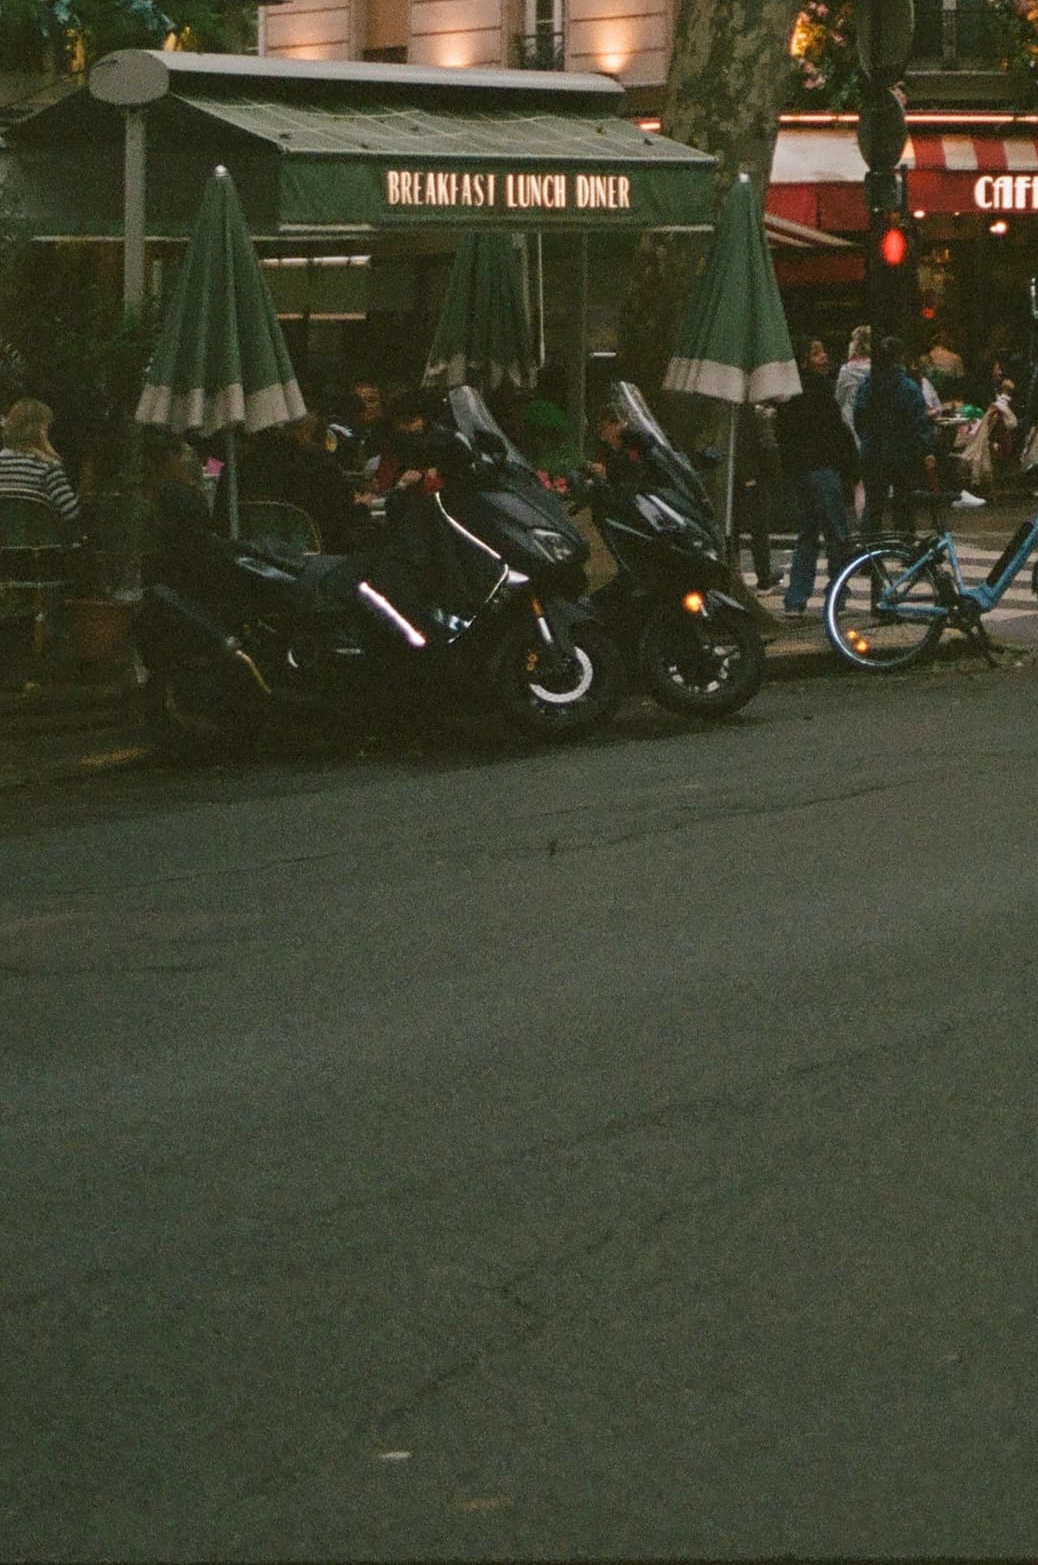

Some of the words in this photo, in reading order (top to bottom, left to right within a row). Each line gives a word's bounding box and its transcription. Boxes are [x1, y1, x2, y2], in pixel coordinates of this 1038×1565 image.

[386, 170, 496, 207] BREAKFAST
[506, 173, 567, 209] LUNCH
[575, 174, 631, 209] DINER
